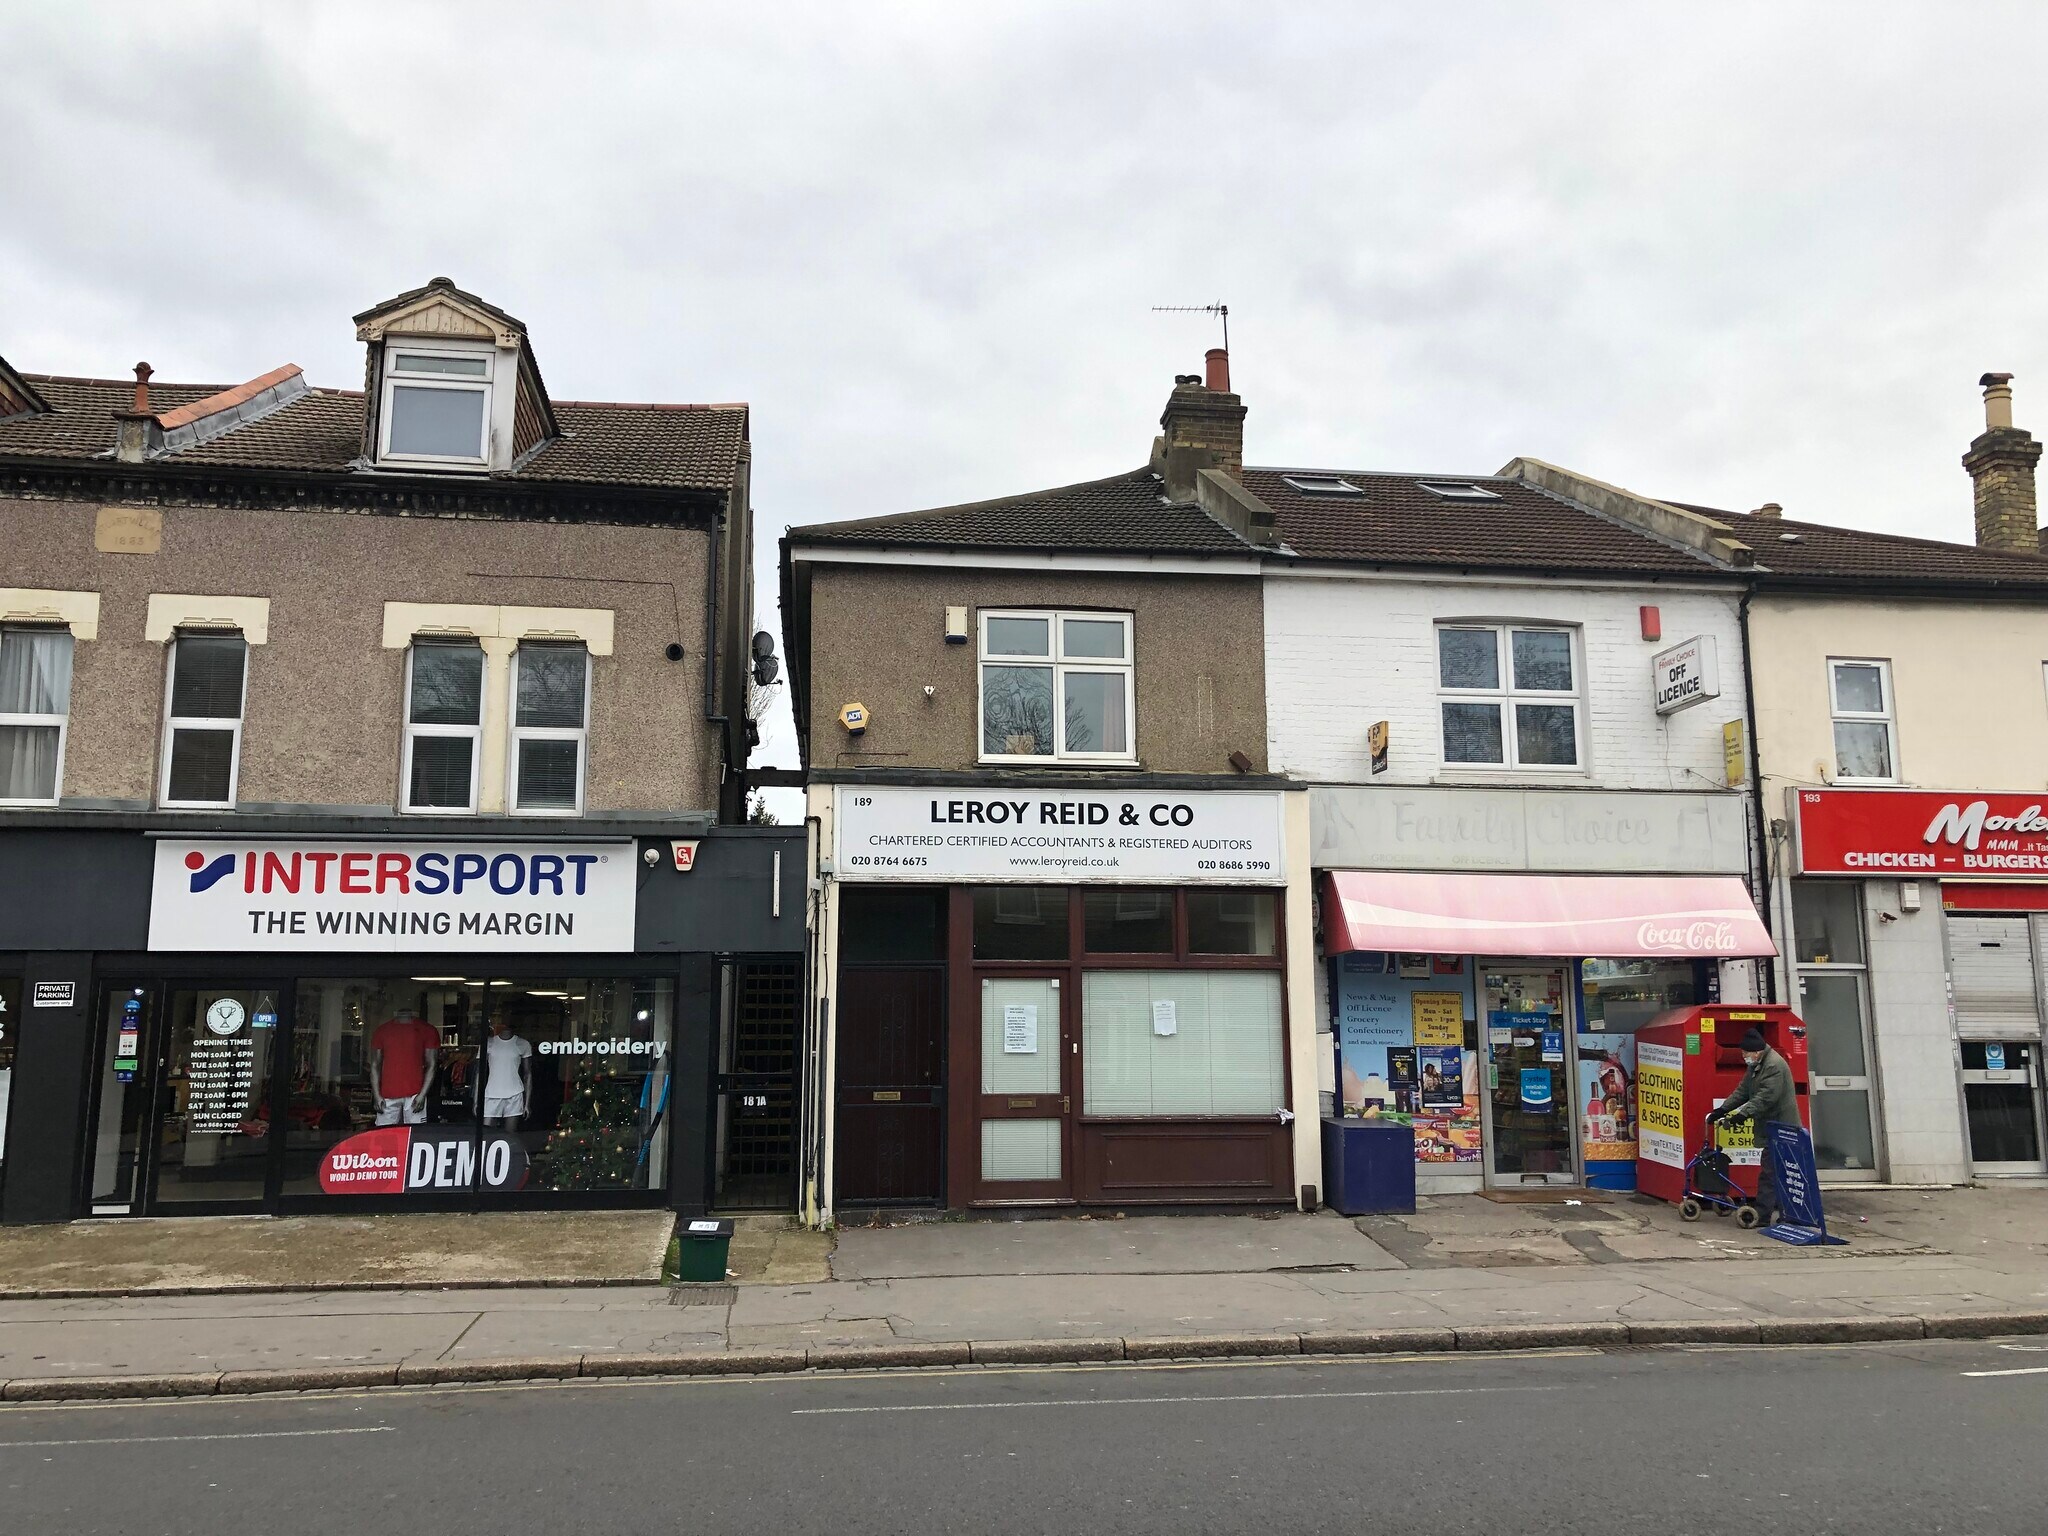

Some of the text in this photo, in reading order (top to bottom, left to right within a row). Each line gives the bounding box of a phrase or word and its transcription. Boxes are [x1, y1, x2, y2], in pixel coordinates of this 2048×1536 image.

[1669, 663, 1686, 683] OFF
[1658, 675, 1700, 705] LICENCE
[847, 711, 862, 721] ADT
[854, 797, 872, 807] 189
[1803, 794, 1821, 803] 193
[931, 800, 1194, 827] LEROY REID & CO
[1923, 800, 2048, 851] Morle
[869, 835, 1253, 851] CHARTERED CERTIFIED ACCOUNTANTS & REGISTERED AUDITORS
[1986, 839, 2019, 851] MMM
[851, 856, 928, 867] 020 8764 6675
[1009, 856, 1120, 869] www.leroyreid.co.uk
[1198, 860, 1271, 871] 020 8686 5990
[1844, 852, 1936, 867] CHICKEN
[243, 851, 599, 896] INTERSPORT
[248, 910, 574, 936] THE WINNING MARGIN
[1636, 920, 1737, 951] Coca-Cola
[1346, 993, 1368, 1001] News
[1378, 993, 1396, 1003] Mag
[1415, 998, 1440, 1006] Opening
[1346, 1004, 1392, 1013] Off Licence
[258, 1014, 272, 1022] OPEN
[1347, 1015, 1380, 1026] Grocery
[1347, 1026, 1404, 1037] Confectionery
[1427, 1024, 1449, 1033] Sunday
[229, 1038, 253, 1046] TIMES
[538, 1037, 668, 1060] embroidery
[1639, 1071, 1682, 1092] CLOTHING
[1640, 1090, 1681, 1111] TEXTILES
[1641, 1108, 1680, 1130] & SHOES
[332, 1140, 511, 1188] Wilson DEMO
[1456, 1154, 1472, 1162] Dairy
[1785, 1160, 1800, 1170] local
[329, 1170, 398, 1182] WORLD DEMO TOUR
[1792, 1195, 1804, 1206] day
